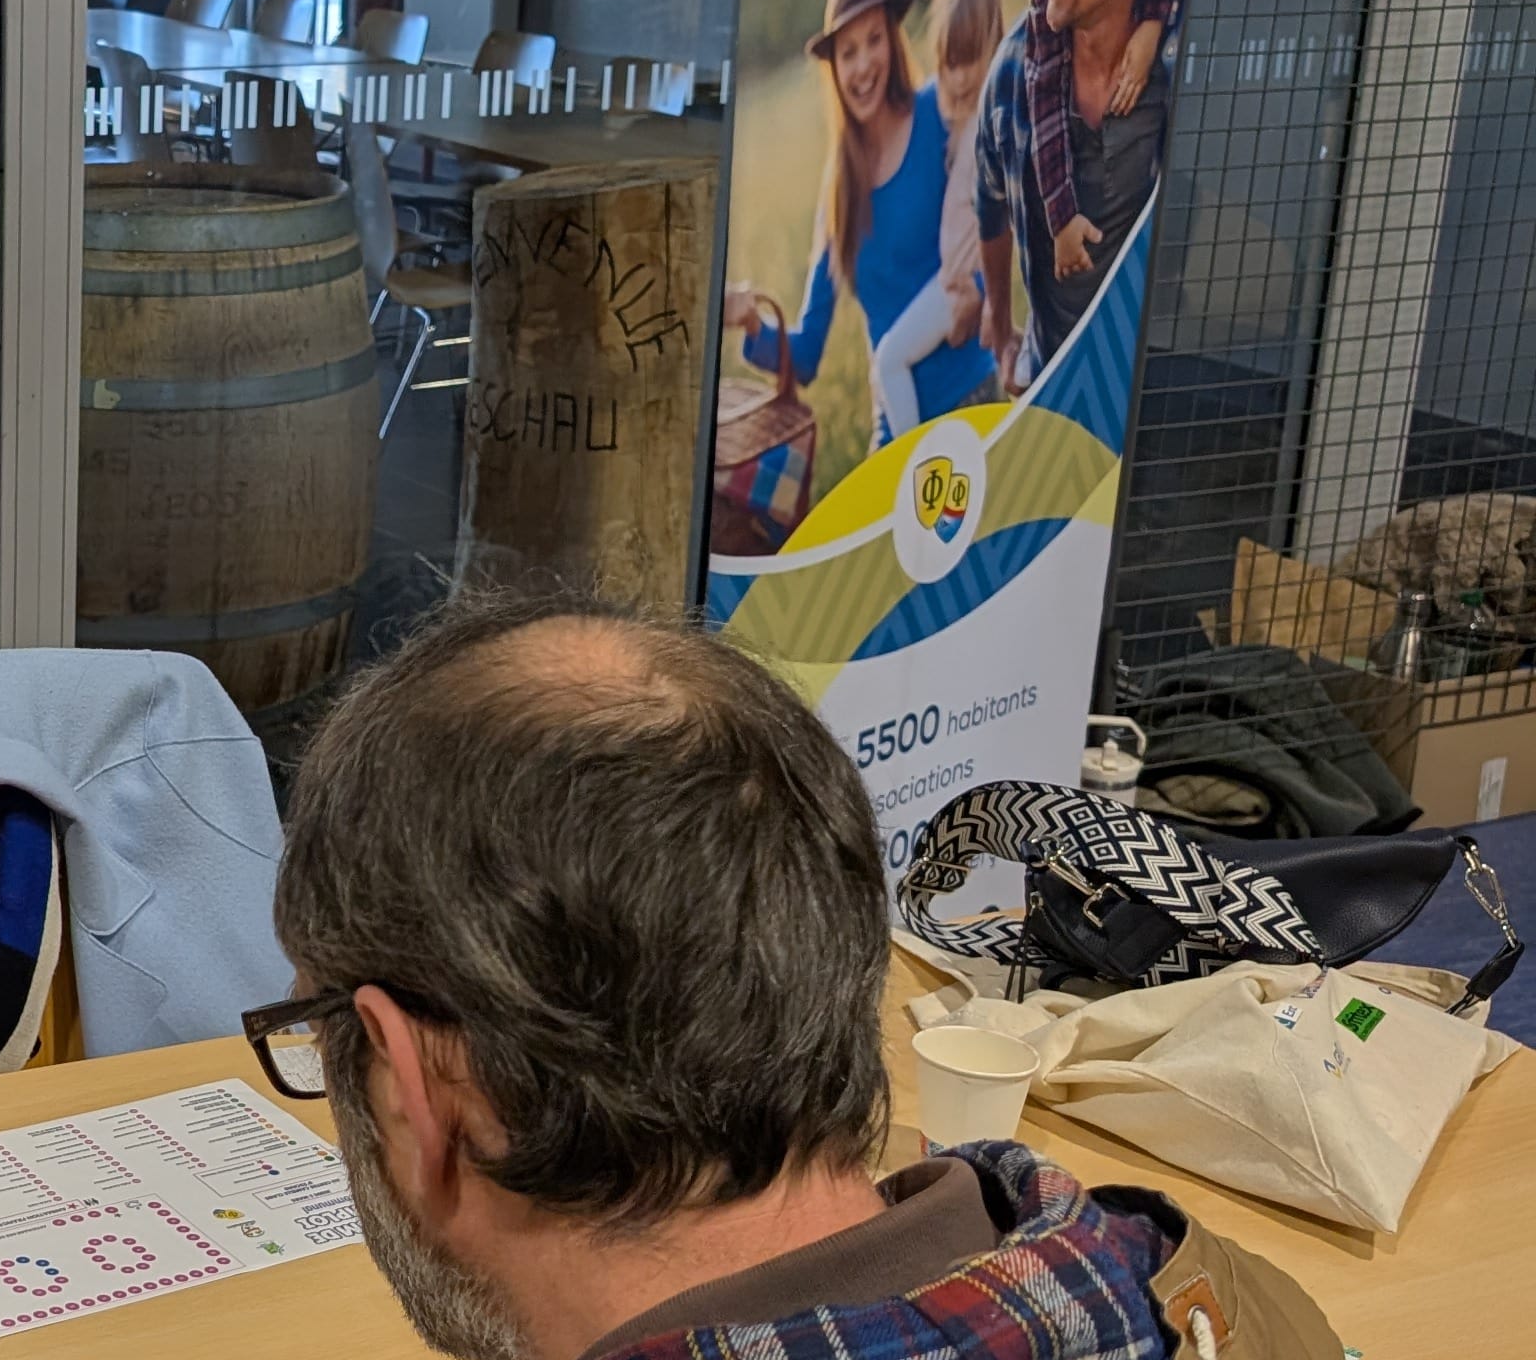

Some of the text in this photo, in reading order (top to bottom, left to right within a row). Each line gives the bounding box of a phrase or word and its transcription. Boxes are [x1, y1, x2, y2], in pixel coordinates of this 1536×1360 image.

[856, 683, 1038, 769] 5500 habitants
[875, 757, 976, 813] sociations
[301, 1195, 352, 1215] ommunal
